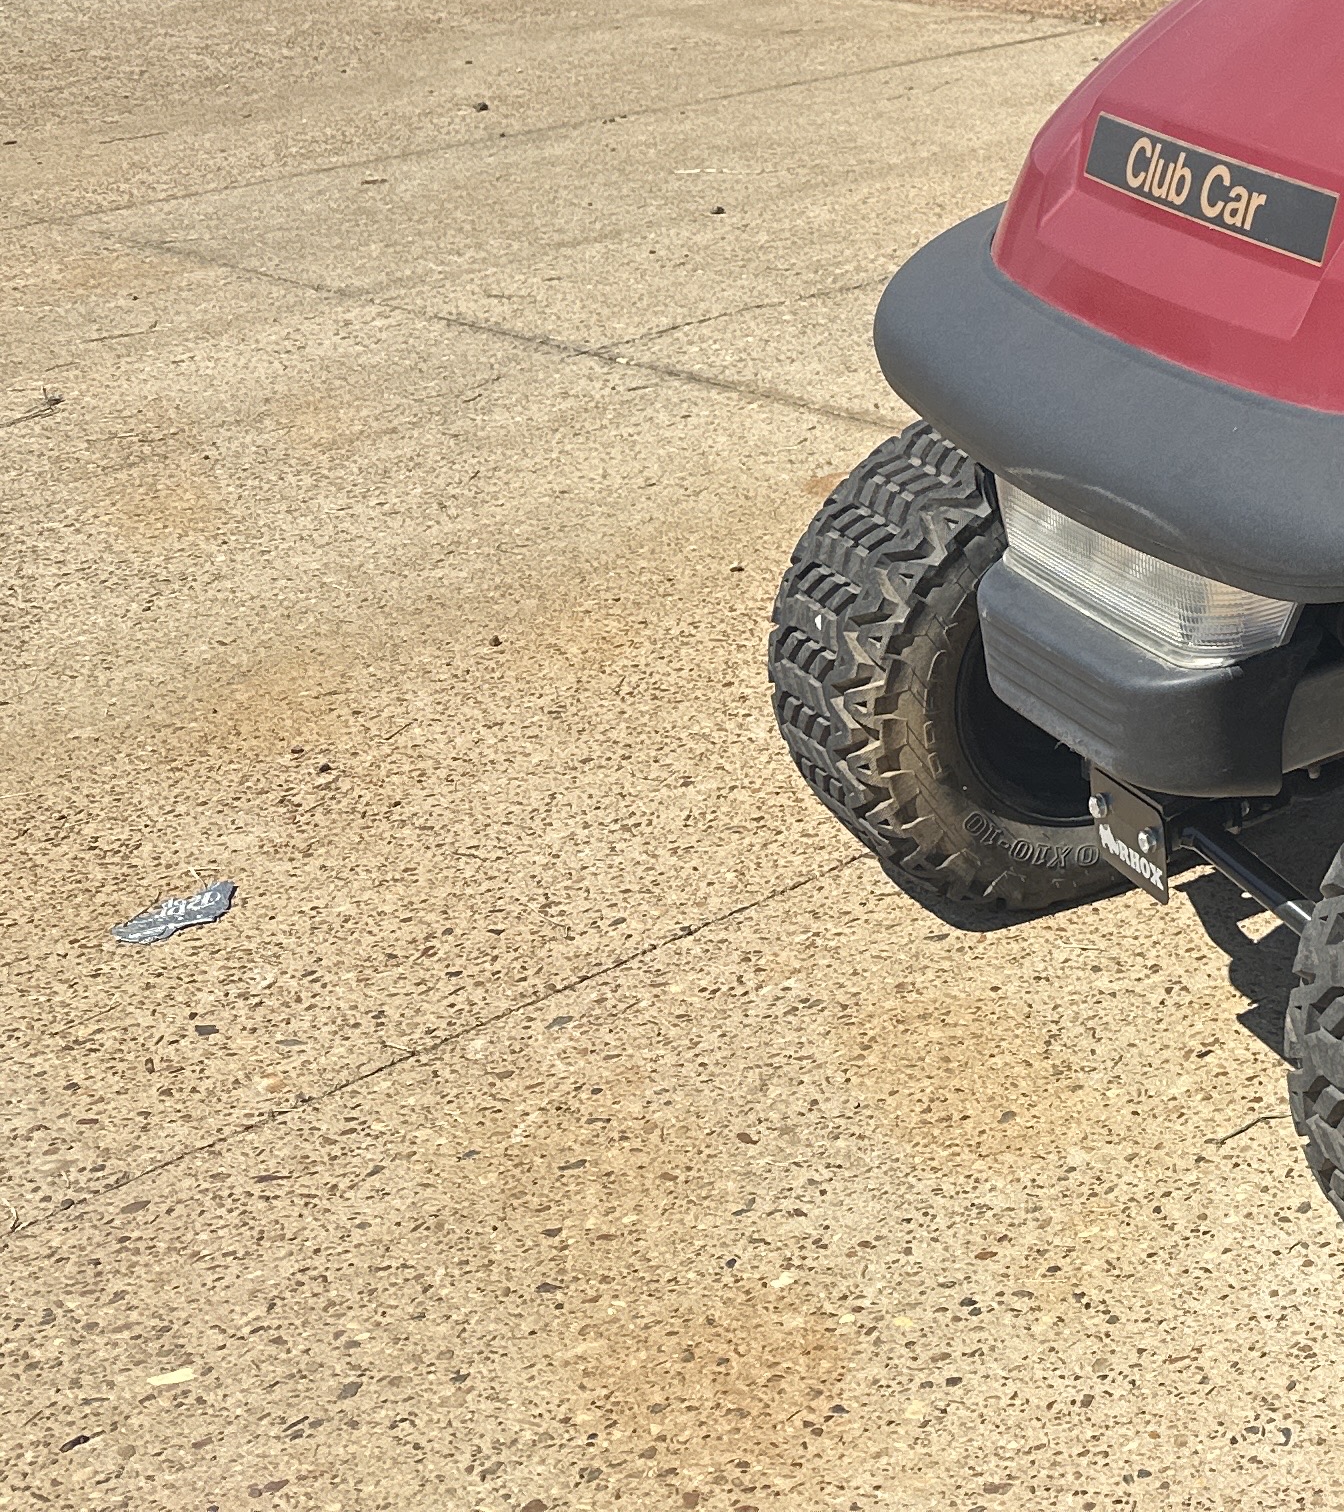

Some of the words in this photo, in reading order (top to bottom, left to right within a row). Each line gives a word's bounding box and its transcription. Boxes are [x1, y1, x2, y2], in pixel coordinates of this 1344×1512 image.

[1126, 137, 1192, 205] Club
[1200, 164, 1267, 231] Car
[962, 810, 1101, 869] 0X10-10
[1117, 839, 1166, 892] RHOX
